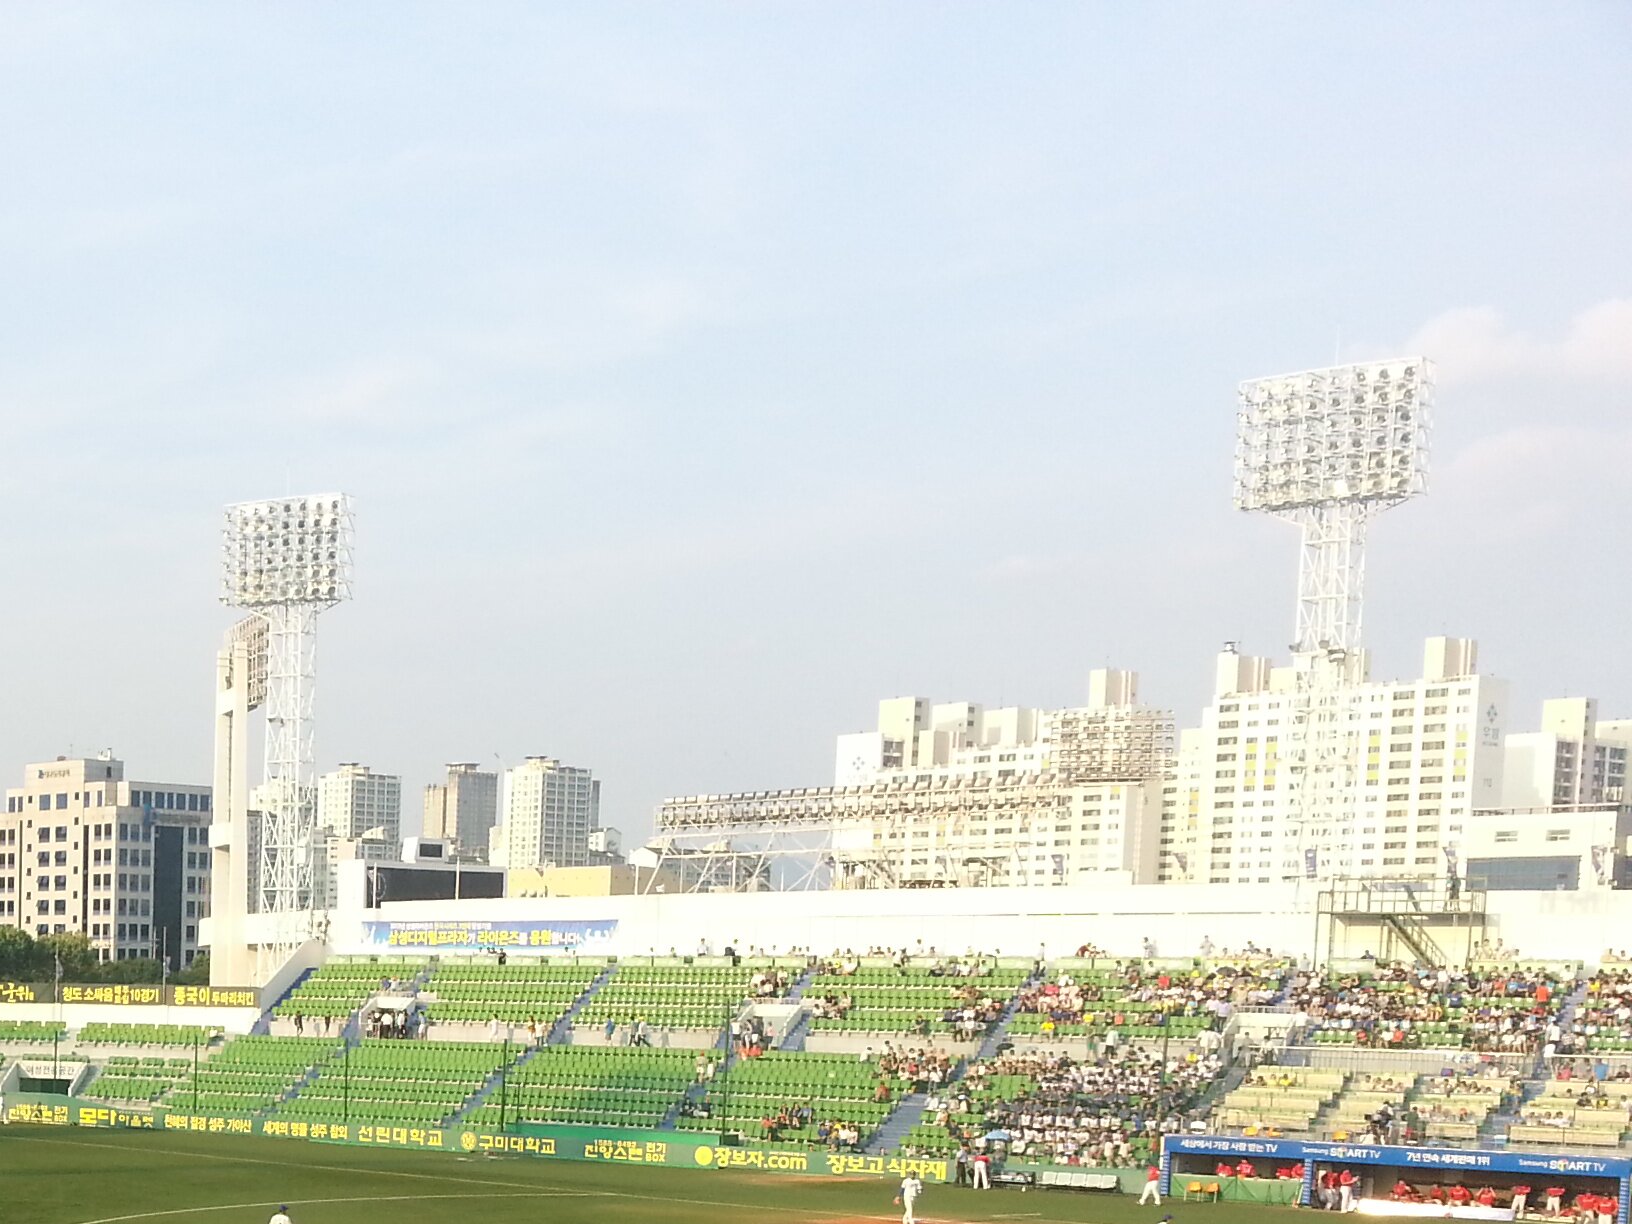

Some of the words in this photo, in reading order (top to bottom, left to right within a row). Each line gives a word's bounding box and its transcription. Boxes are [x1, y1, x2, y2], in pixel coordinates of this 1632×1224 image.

[212, 991, 254, 1006] 두마리치킨
[208, 1117, 225, 1132] 성주
[262, 1120, 288, 1136] 세계의
[309, 1123, 328, 1138] 성주
[358, 1125, 443, 1147] 선린대학교
[478, 1134, 556, 1155] 구미대학교
[1265, 1143, 1278, 1153] TV
[645, 1153, 666, 1162] BOX
[713, 1147, 808, 1171] 장보자.com
[1369, 1150, 1382, 1159] TV
[826, 1154, 885, 1175] 장보고
[886, 1158, 947, 1180] 식자재
[1593, 1161, 1607, 1172] TV
